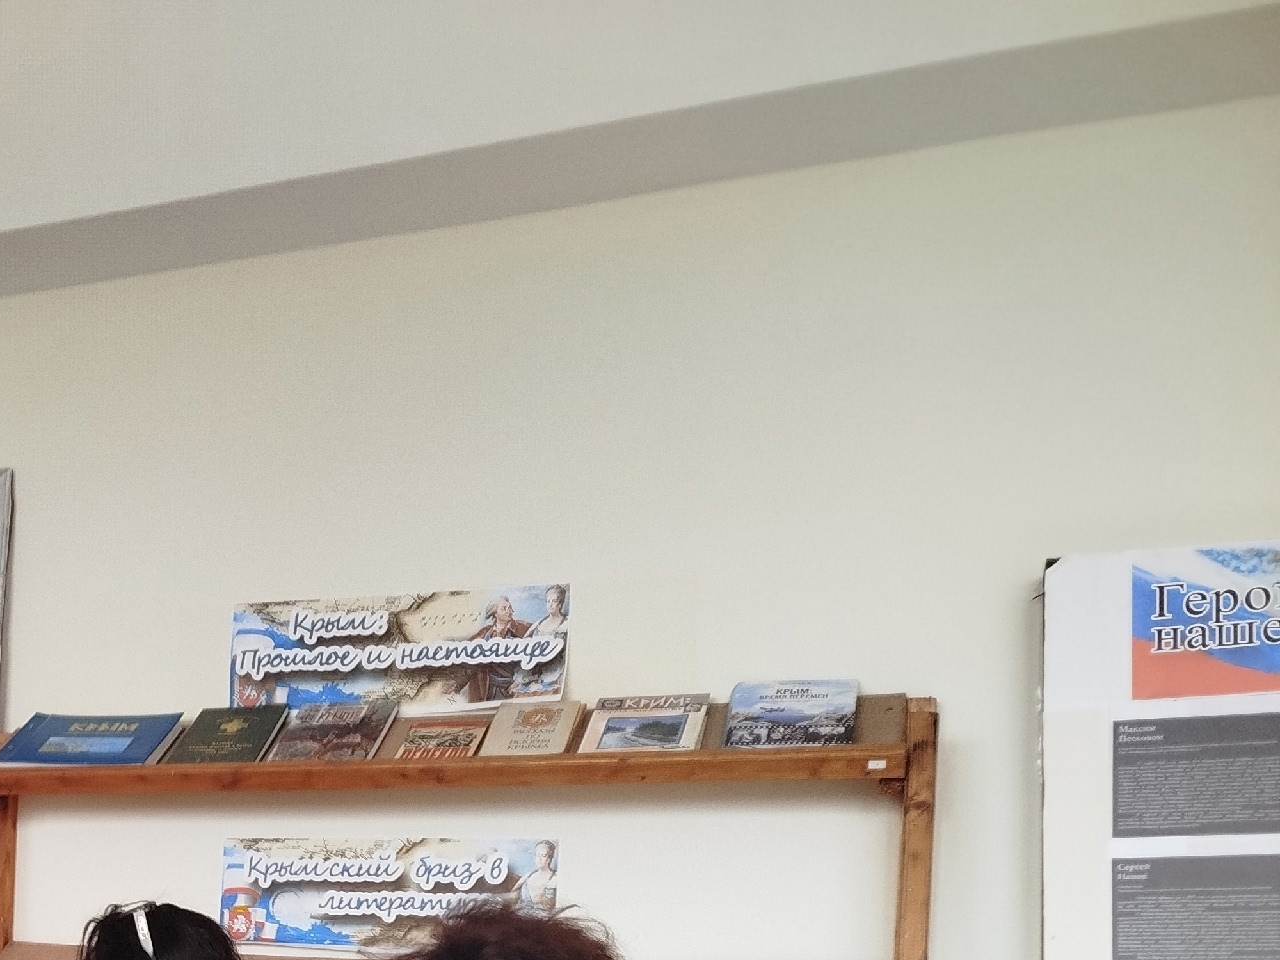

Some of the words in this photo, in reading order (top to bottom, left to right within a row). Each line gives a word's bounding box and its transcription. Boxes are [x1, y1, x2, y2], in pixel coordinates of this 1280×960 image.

[1151, 582, 1280, 624] Геро
[292, 611, 387, 641] Крым:
[1152, 618, 1280, 652] наше
[239, 648, 359, 677] Прошлое
[365, 646, 392, 666] и
[399, 637, 558, 668] настоящее
[66, 722, 139, 733] КРЫМ
[248, 855, 401, 886] Крымский
[416, 856, 480, 886] бриз
[489, 857, 505, 880] в
